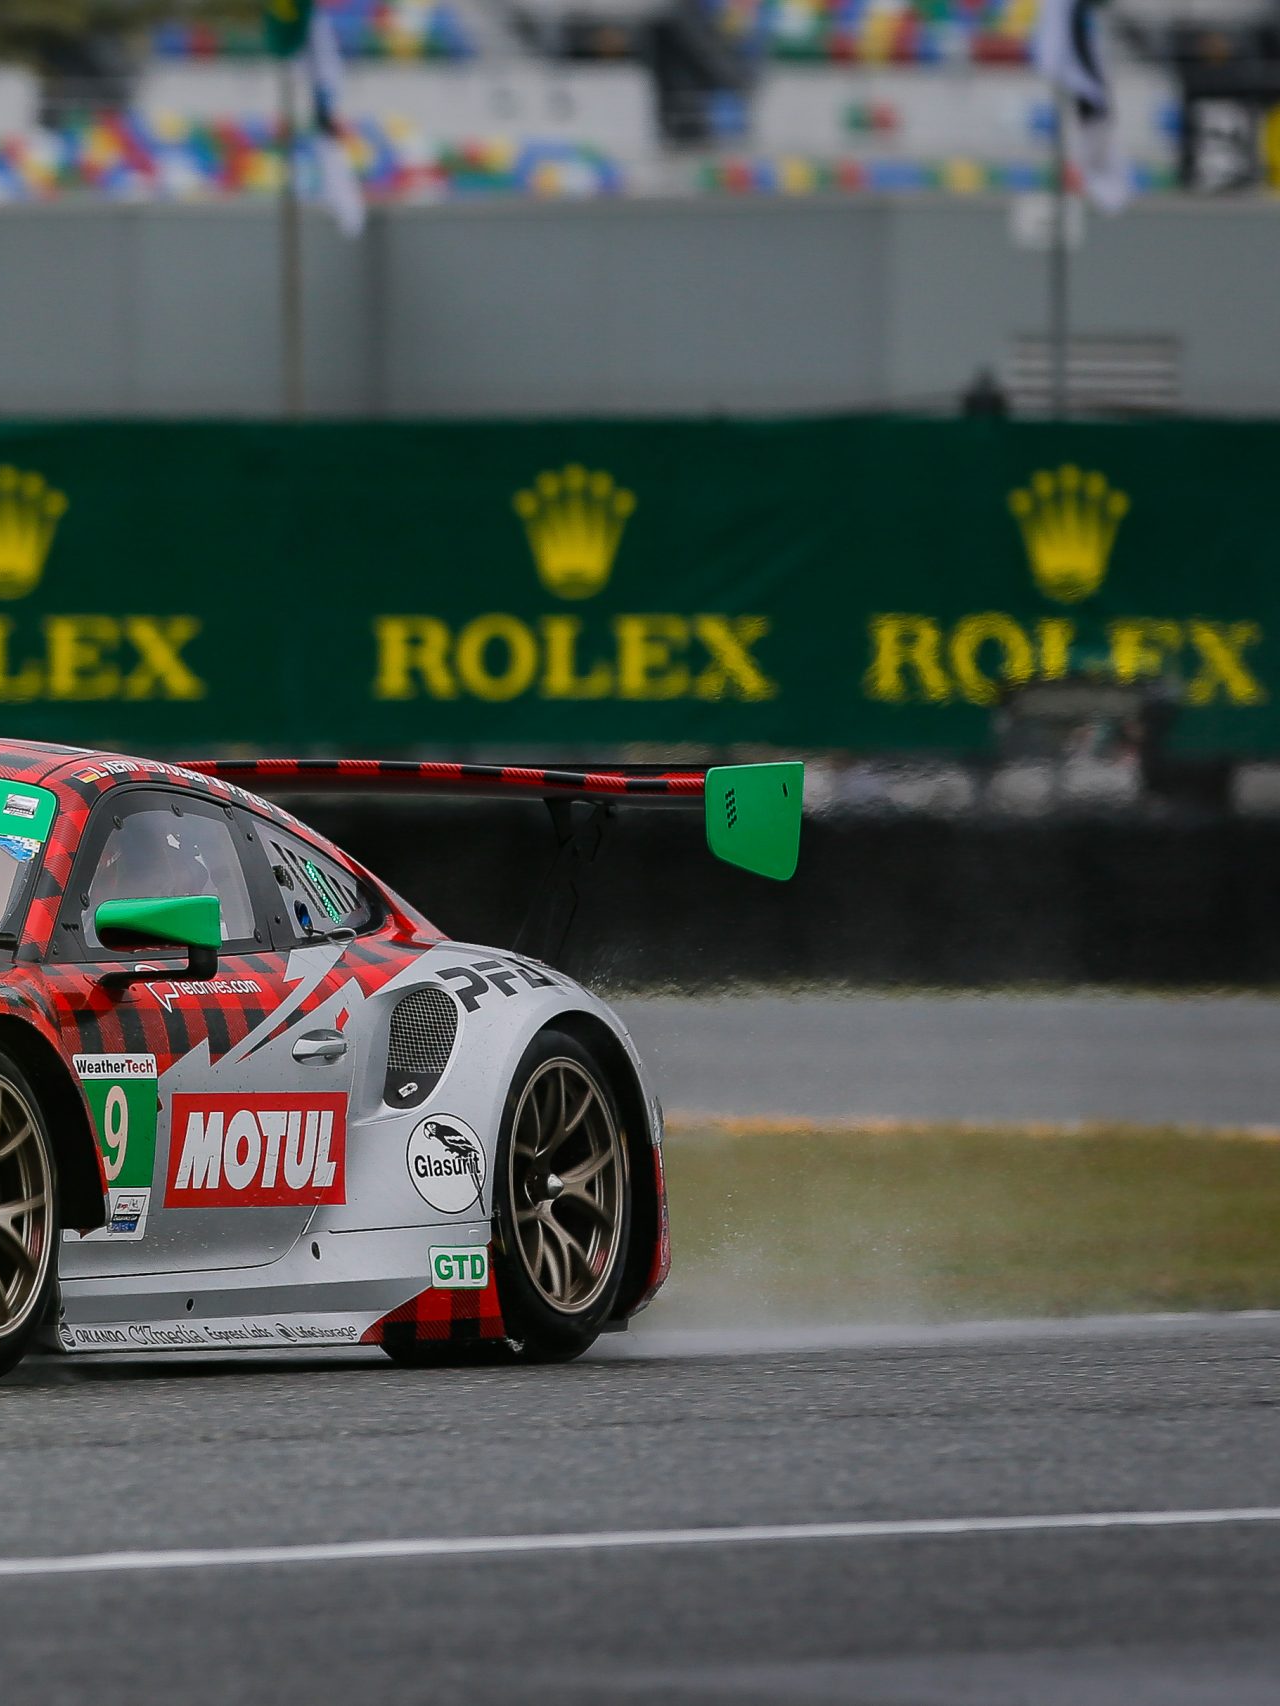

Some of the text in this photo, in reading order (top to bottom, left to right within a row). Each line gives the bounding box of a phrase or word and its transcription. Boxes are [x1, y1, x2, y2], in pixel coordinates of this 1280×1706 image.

[373, 610, 777, 701] ROLEX
[75, 1059, 155, 1074] WeatherTech
[103, 1084, 129, 1181] 9
[173, 1109, 337, 1190] MOTUL
[414, 1153, 482, 1178] Glasurit
[434, 1254, 485, 1281] GTD
[75, 1329, 127, 1343] ORLANDO
[204, 1326, 249, 1344] Express
